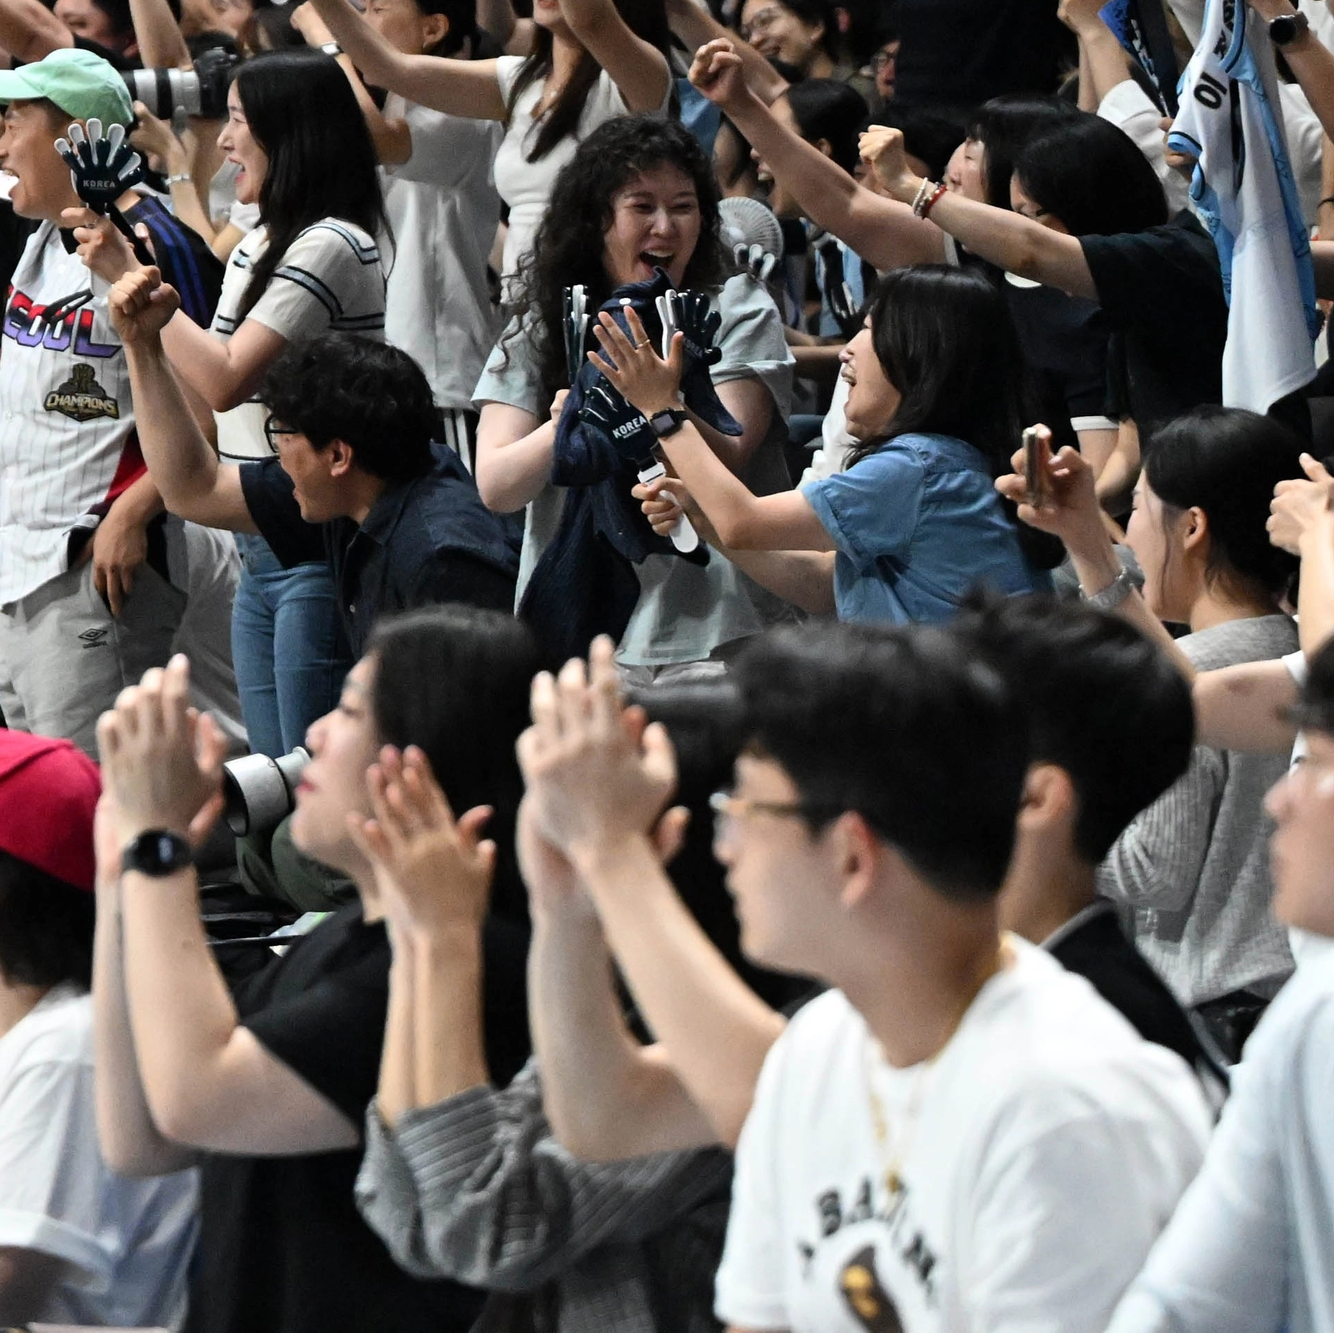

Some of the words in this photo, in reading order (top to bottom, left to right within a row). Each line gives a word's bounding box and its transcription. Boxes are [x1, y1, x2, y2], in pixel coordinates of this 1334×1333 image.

[82, 179, 116, 188] KOREA
[2, 283, 123, 359] EOUL
[46, 393, 116, 413] CHAMPIONS
[611, 414, 648, 439] KOREA
